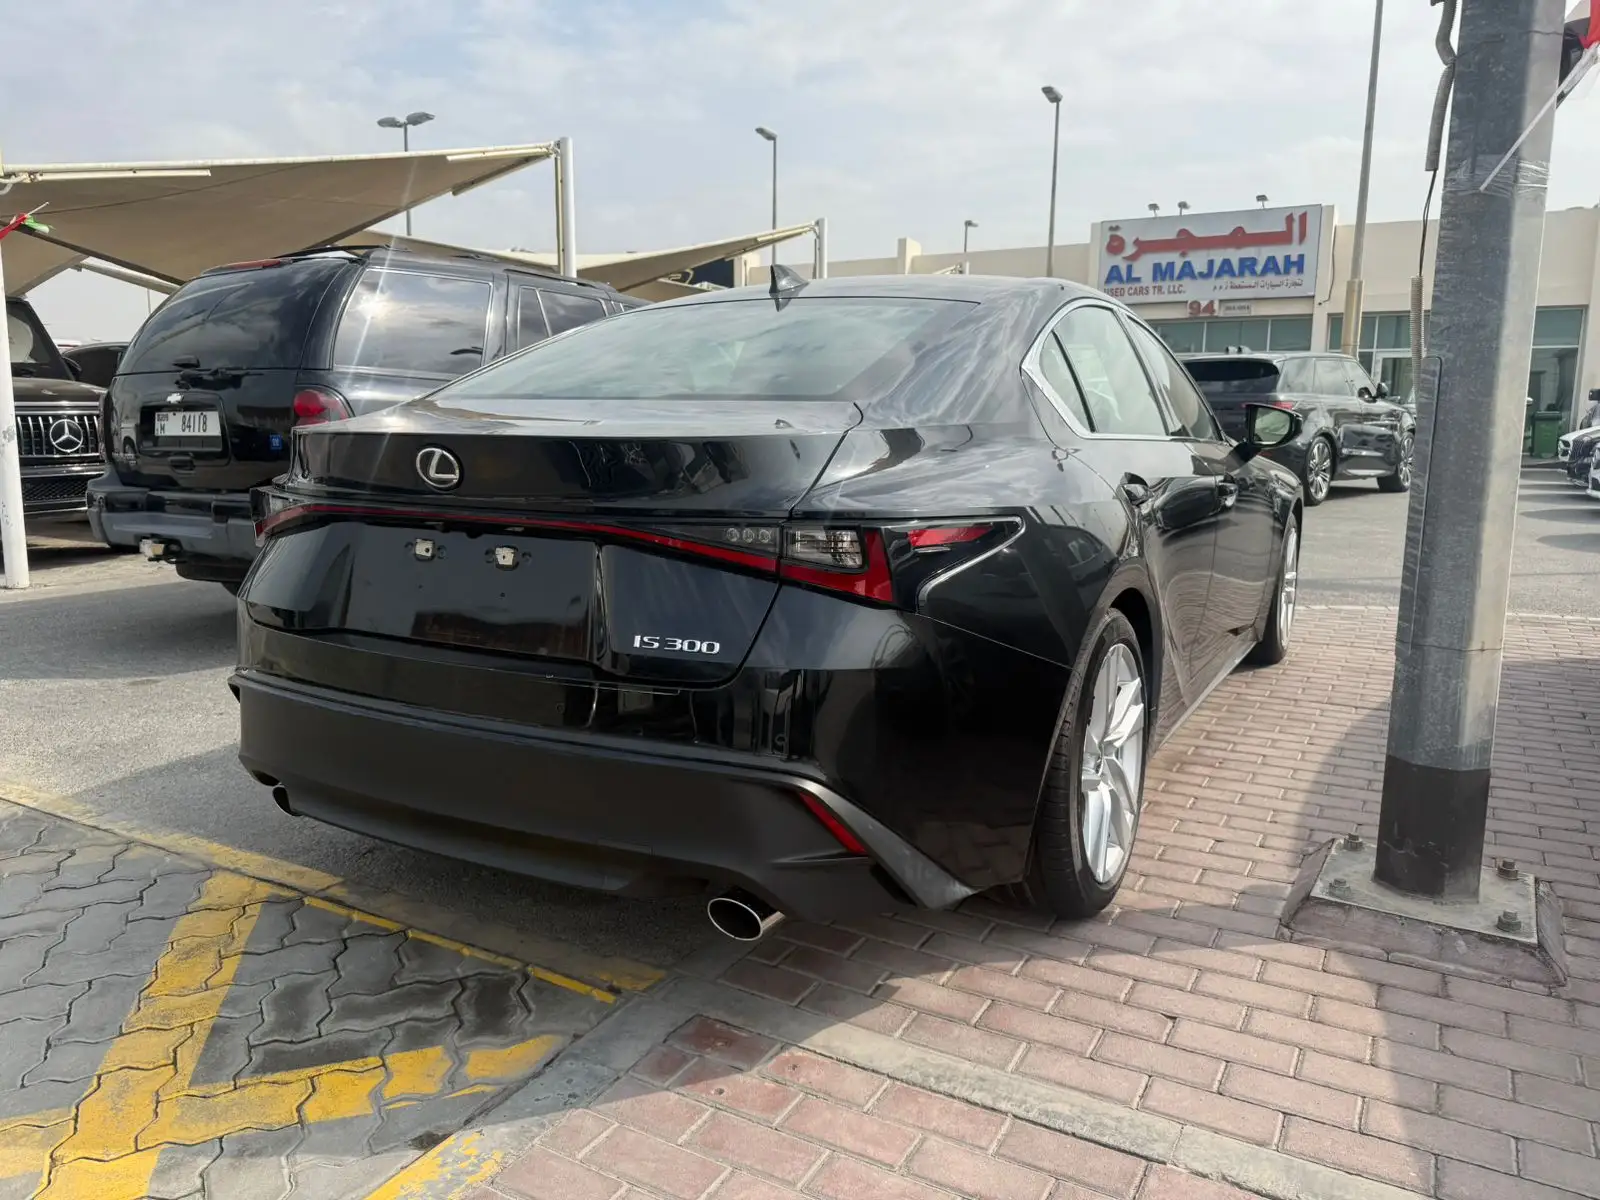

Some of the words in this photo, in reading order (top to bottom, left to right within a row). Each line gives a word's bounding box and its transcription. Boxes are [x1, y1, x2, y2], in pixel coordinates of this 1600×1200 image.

[1106, 212, 1307, 262] المجرة
[1104, 264, 1142, 285] AL
[1152, 254, 1305, 282] MAJARAH
[1127, 286, 1150, 296] CARS
[1188, 299, 1216, 316] 94
[181, 413, 208, 433] 84118
[633, 635, 660, 649] IS
[663, 637, 720, 654] 300
